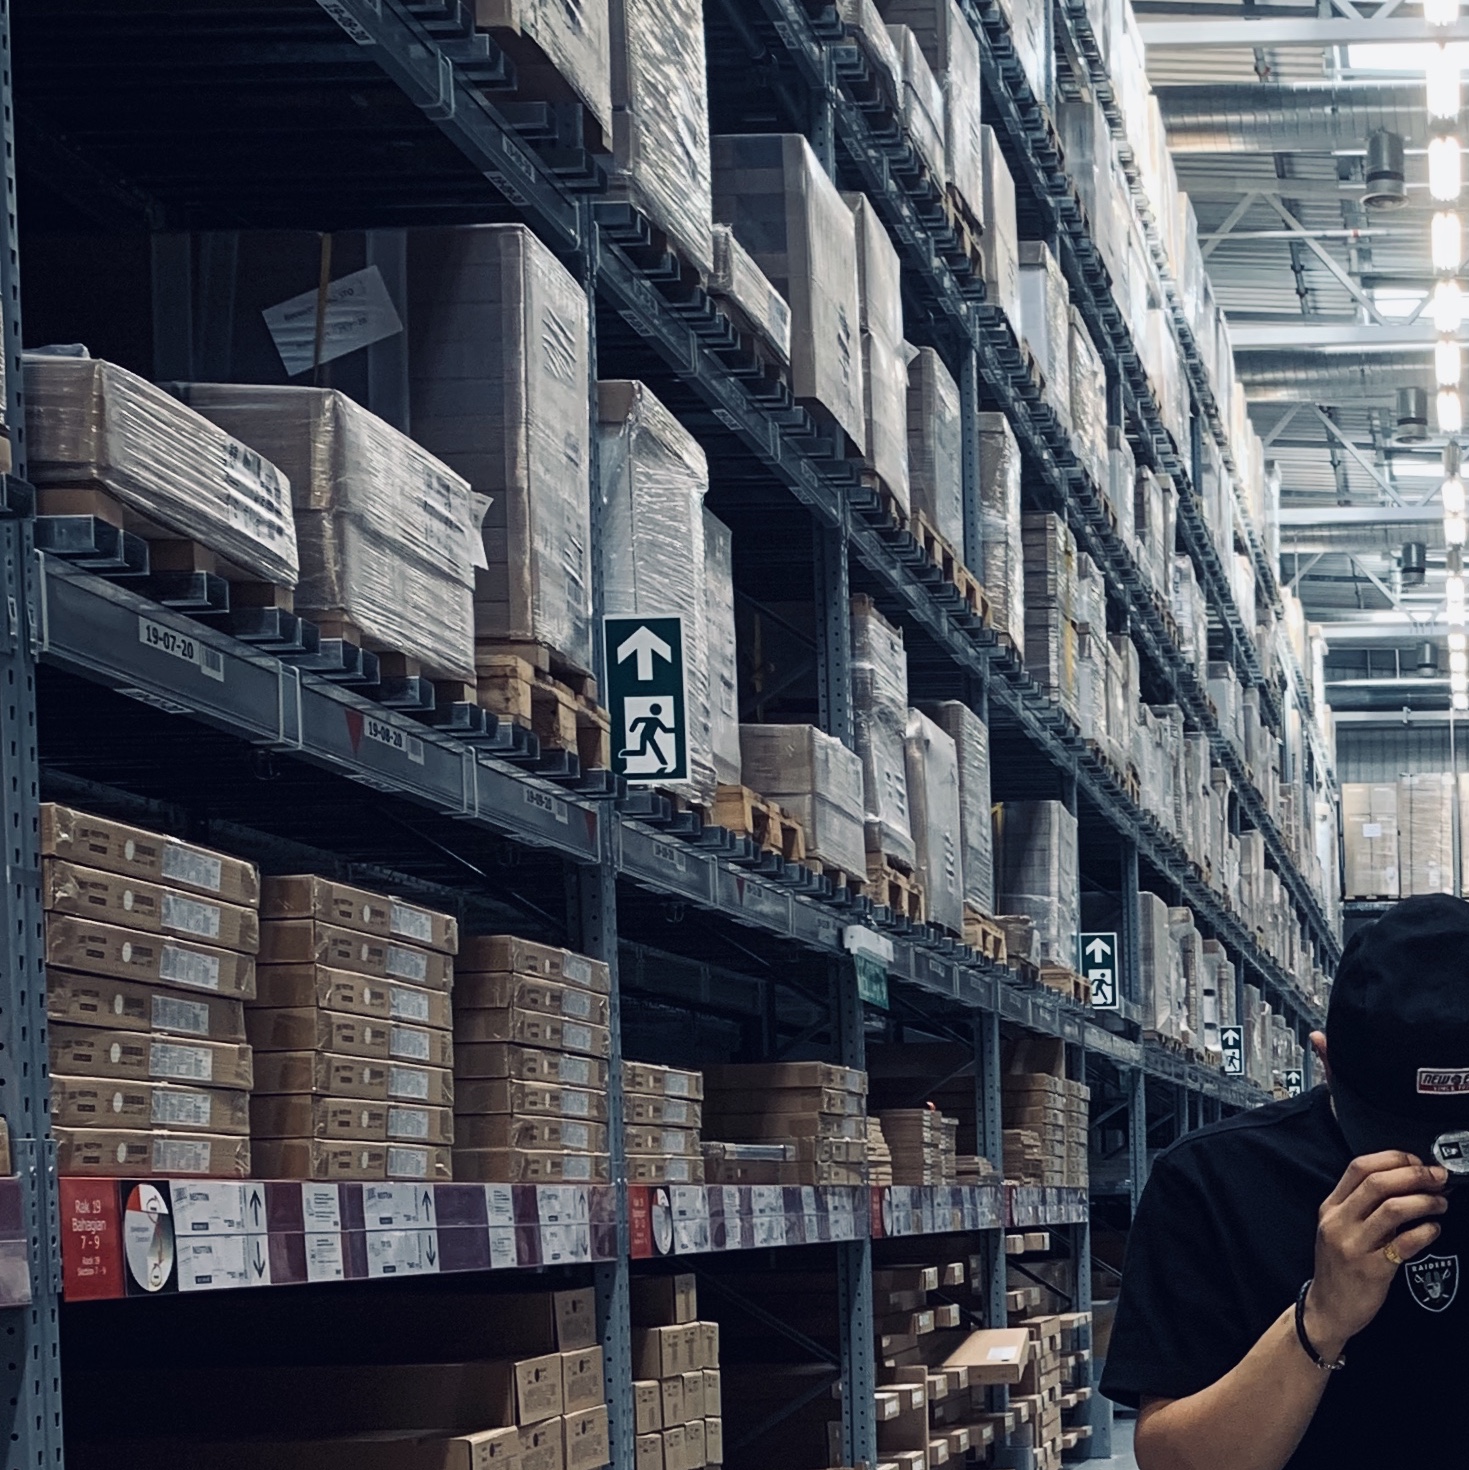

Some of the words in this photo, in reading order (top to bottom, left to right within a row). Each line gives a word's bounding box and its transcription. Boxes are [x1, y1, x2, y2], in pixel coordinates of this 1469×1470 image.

[146, 624, 194, 659] 19-07-20
[75, 1199, 91, 1214] Rak
[92, 1199, 102, 1214] 19
[72, 1217, 107, 1235] Bahagian
[1411, 1260, 1452, 1272] RAIDERS
